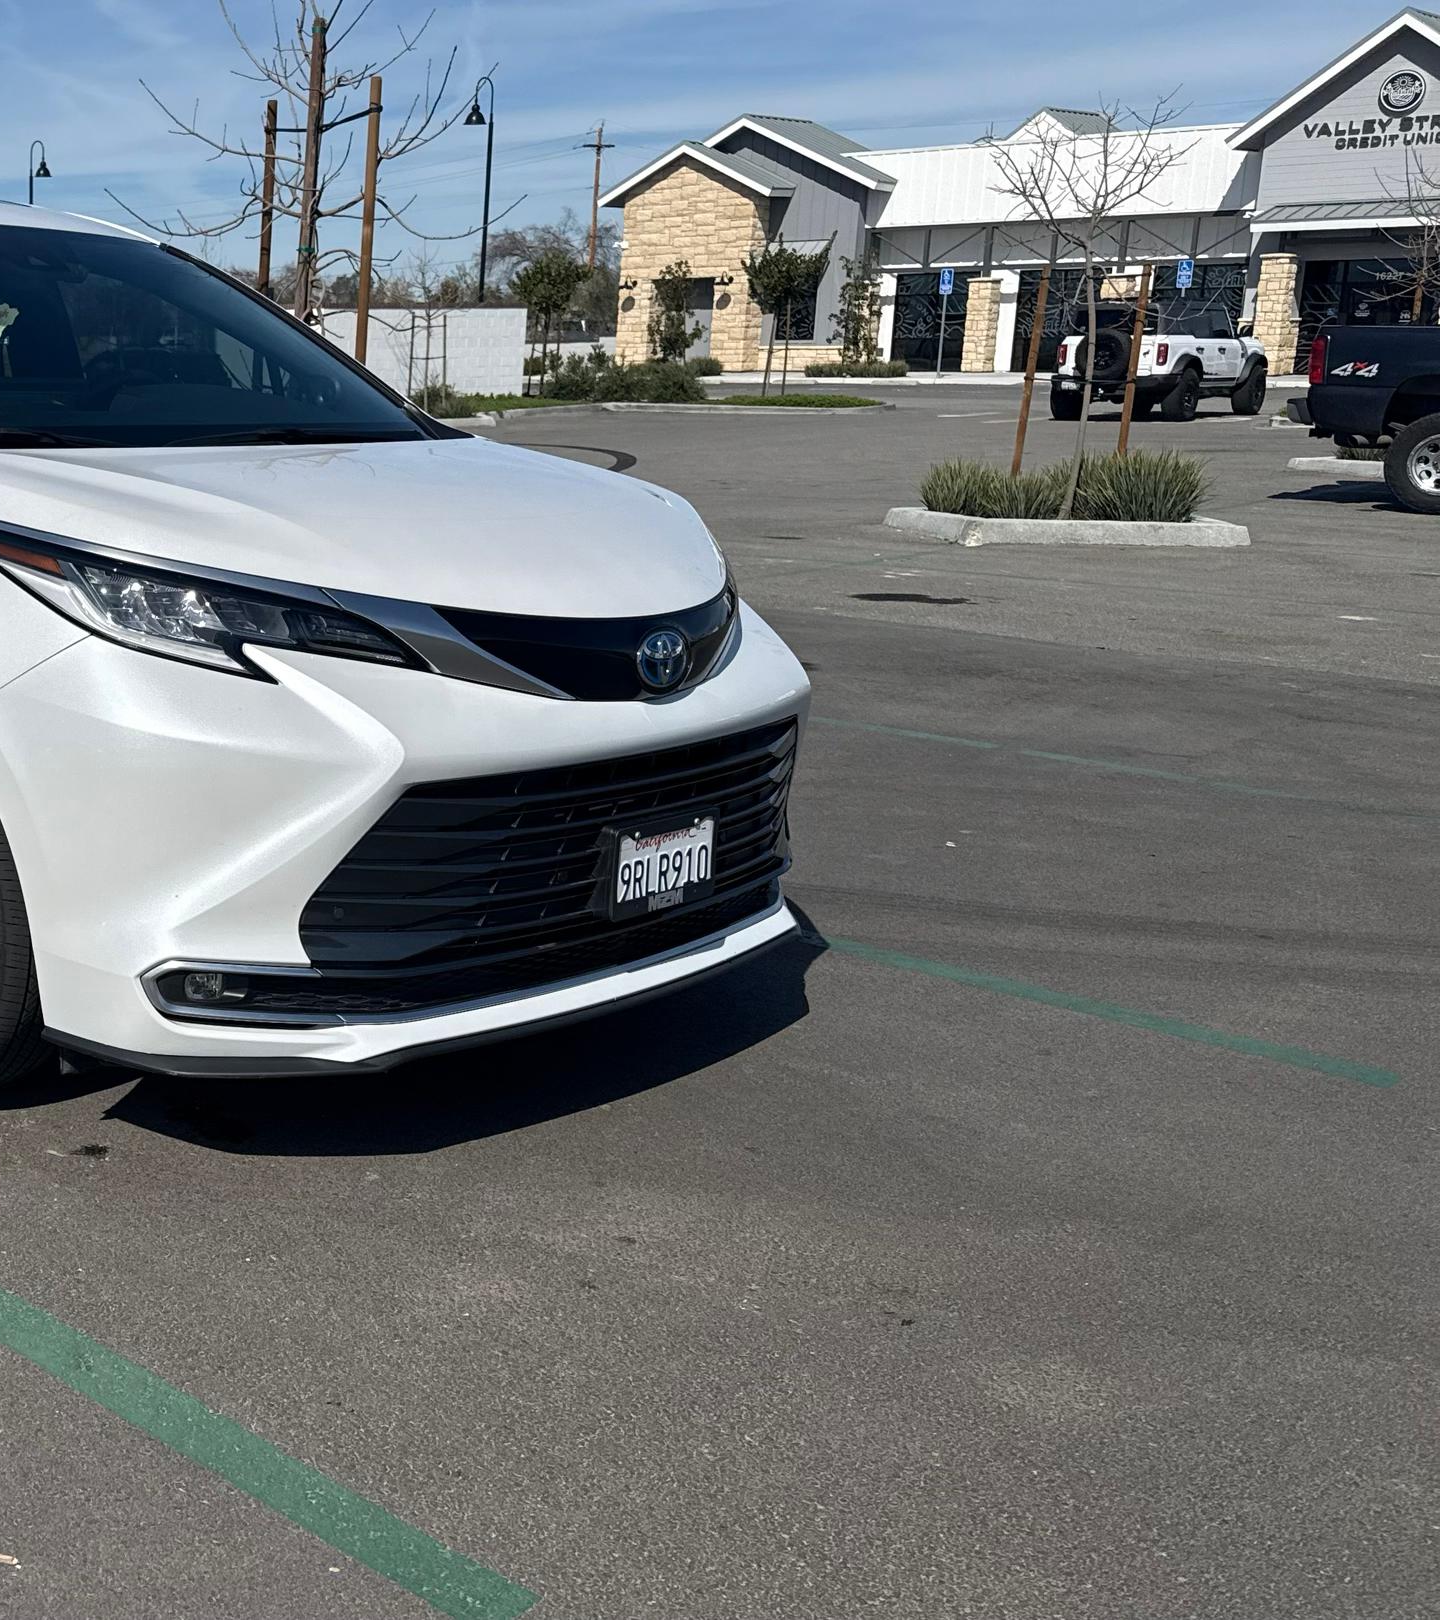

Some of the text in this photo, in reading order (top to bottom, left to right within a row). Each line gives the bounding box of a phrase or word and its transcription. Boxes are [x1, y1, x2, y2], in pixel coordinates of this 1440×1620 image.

[1303, 117, 1393, 139] VALLEY
[1334, 133, 1400, 151] CREDIT
[616, 843, 710, 904] 9RLR910
